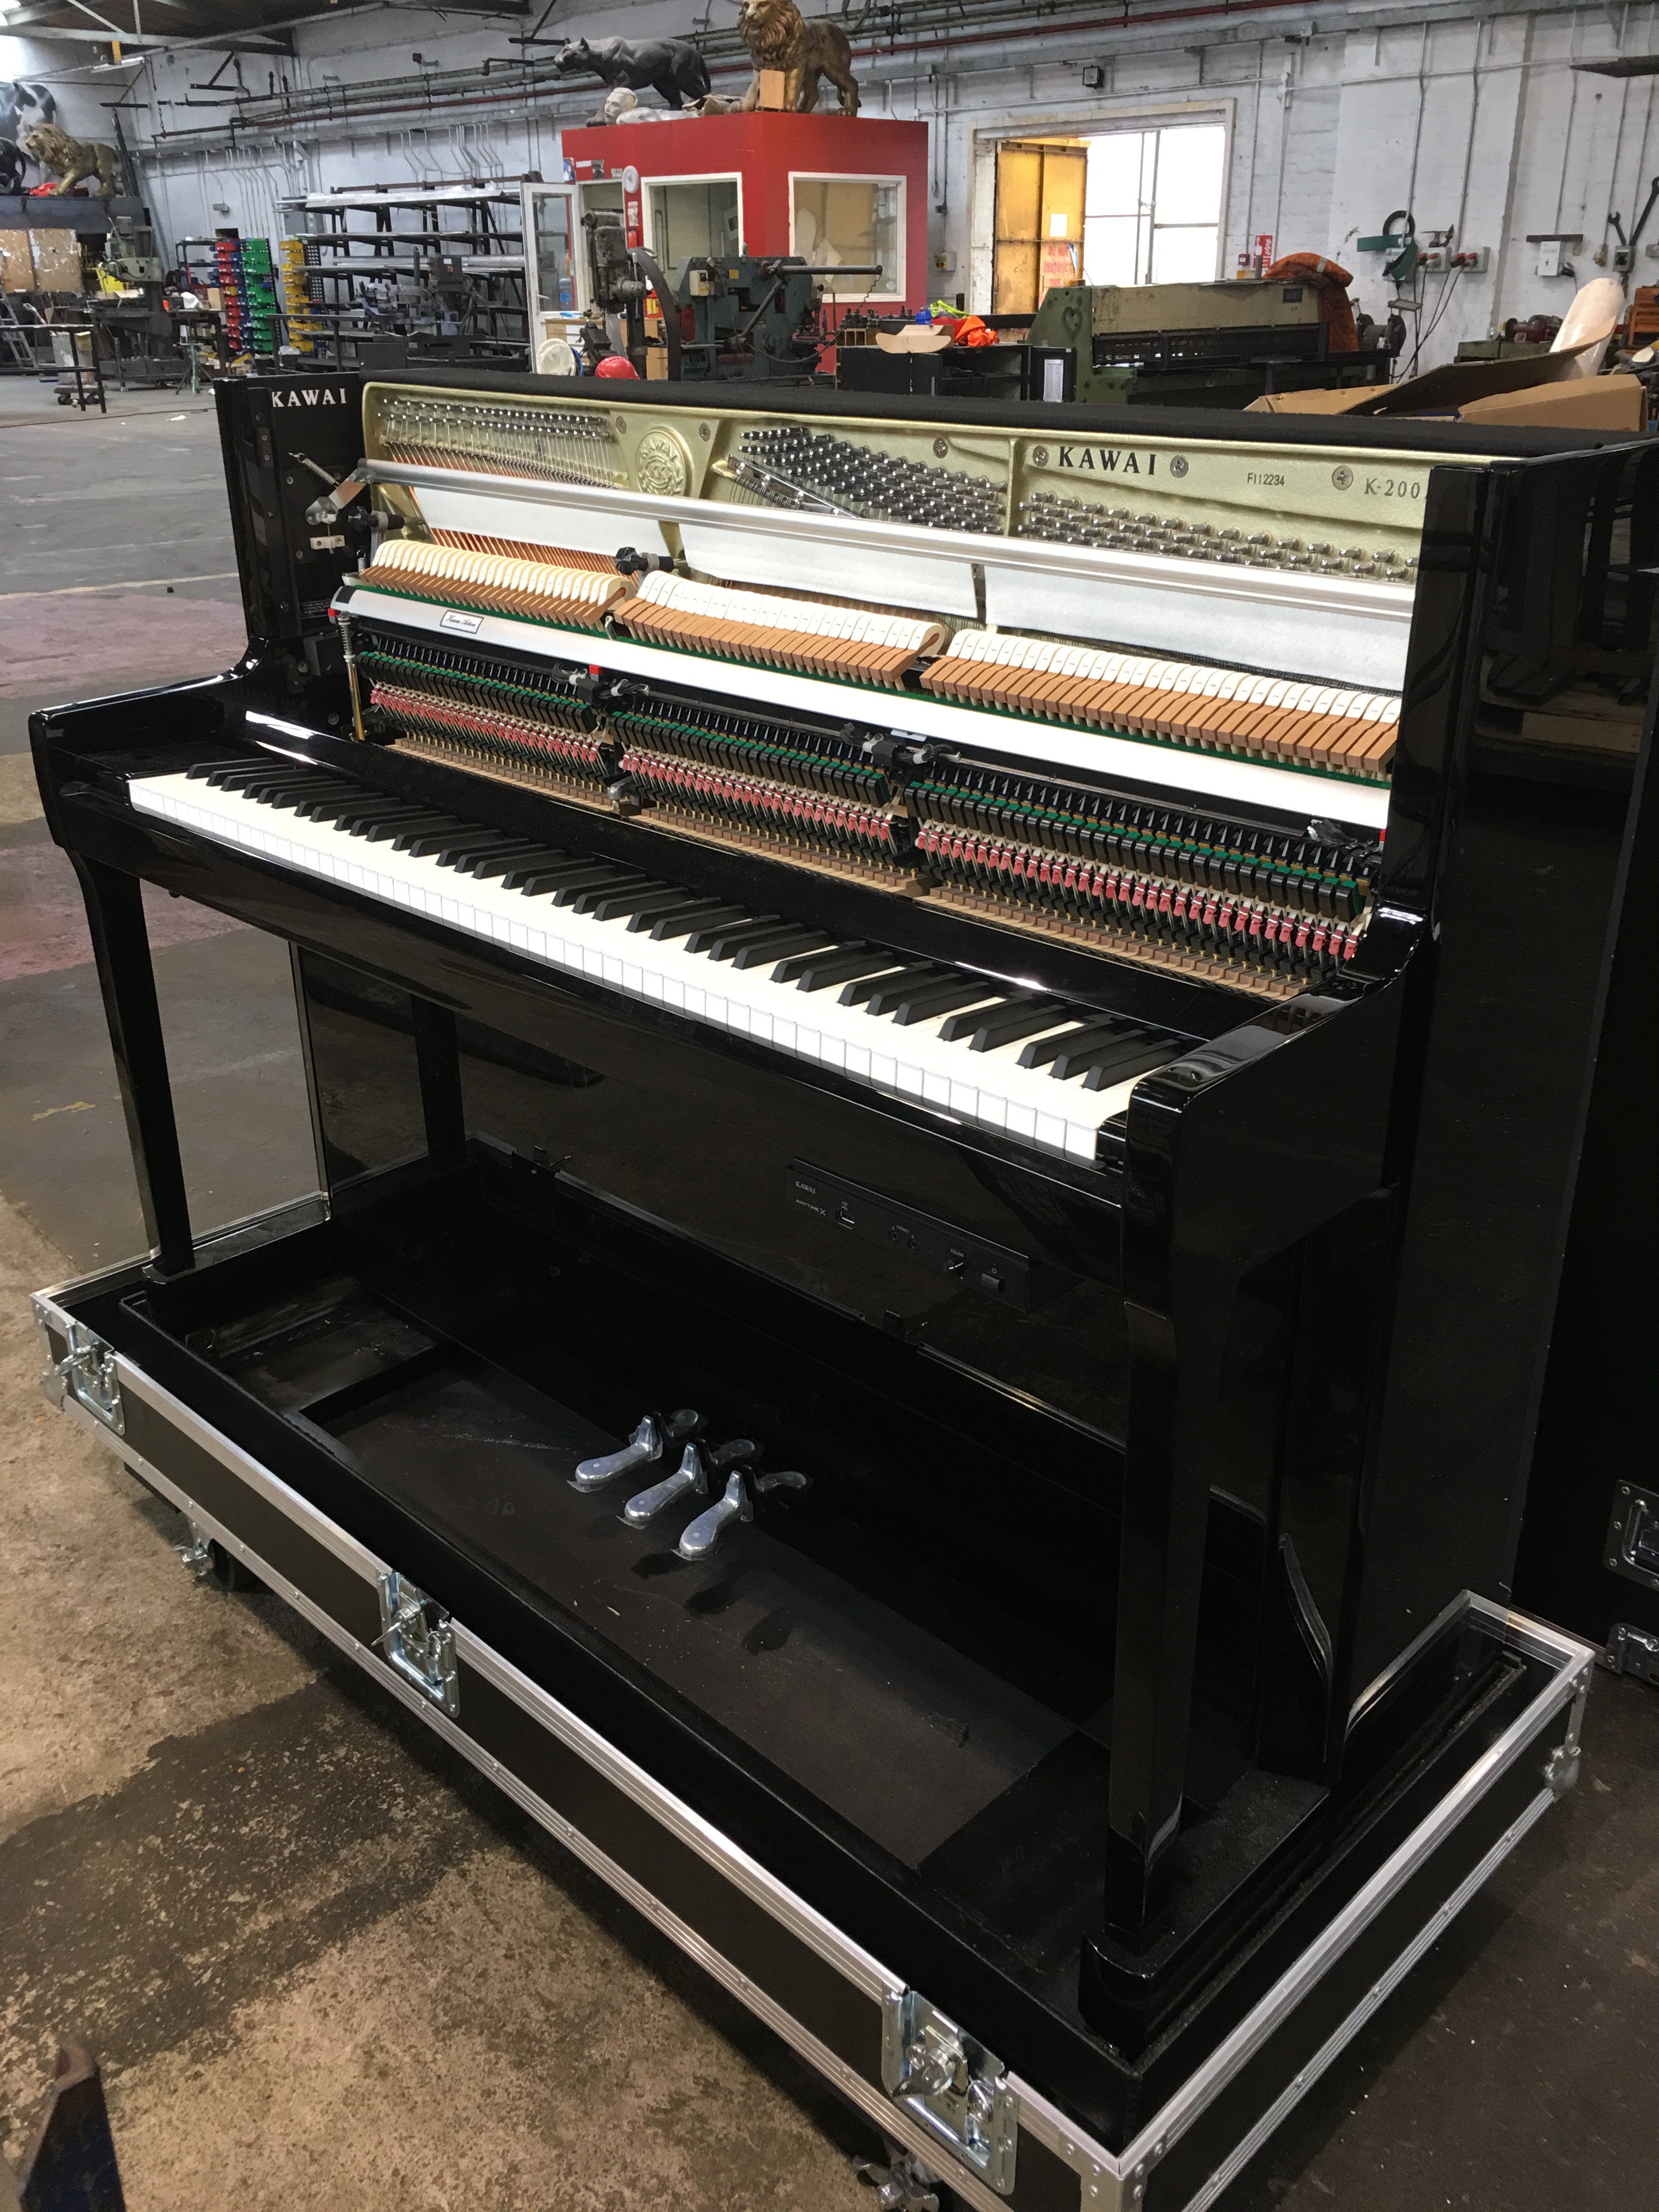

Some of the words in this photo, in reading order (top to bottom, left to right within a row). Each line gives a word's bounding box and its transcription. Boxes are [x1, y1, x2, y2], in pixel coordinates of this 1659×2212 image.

[272, 388, 347, 408] KAWAI
[640, 438, 678, 462] KAWAI
[1059, 446, 1156, 476] KAWAI
[1247, 472, 1285, 487] F112234
[1364, 478, 1427, 499] K-200
[795, 1180, 816, 1194] KAWAI
